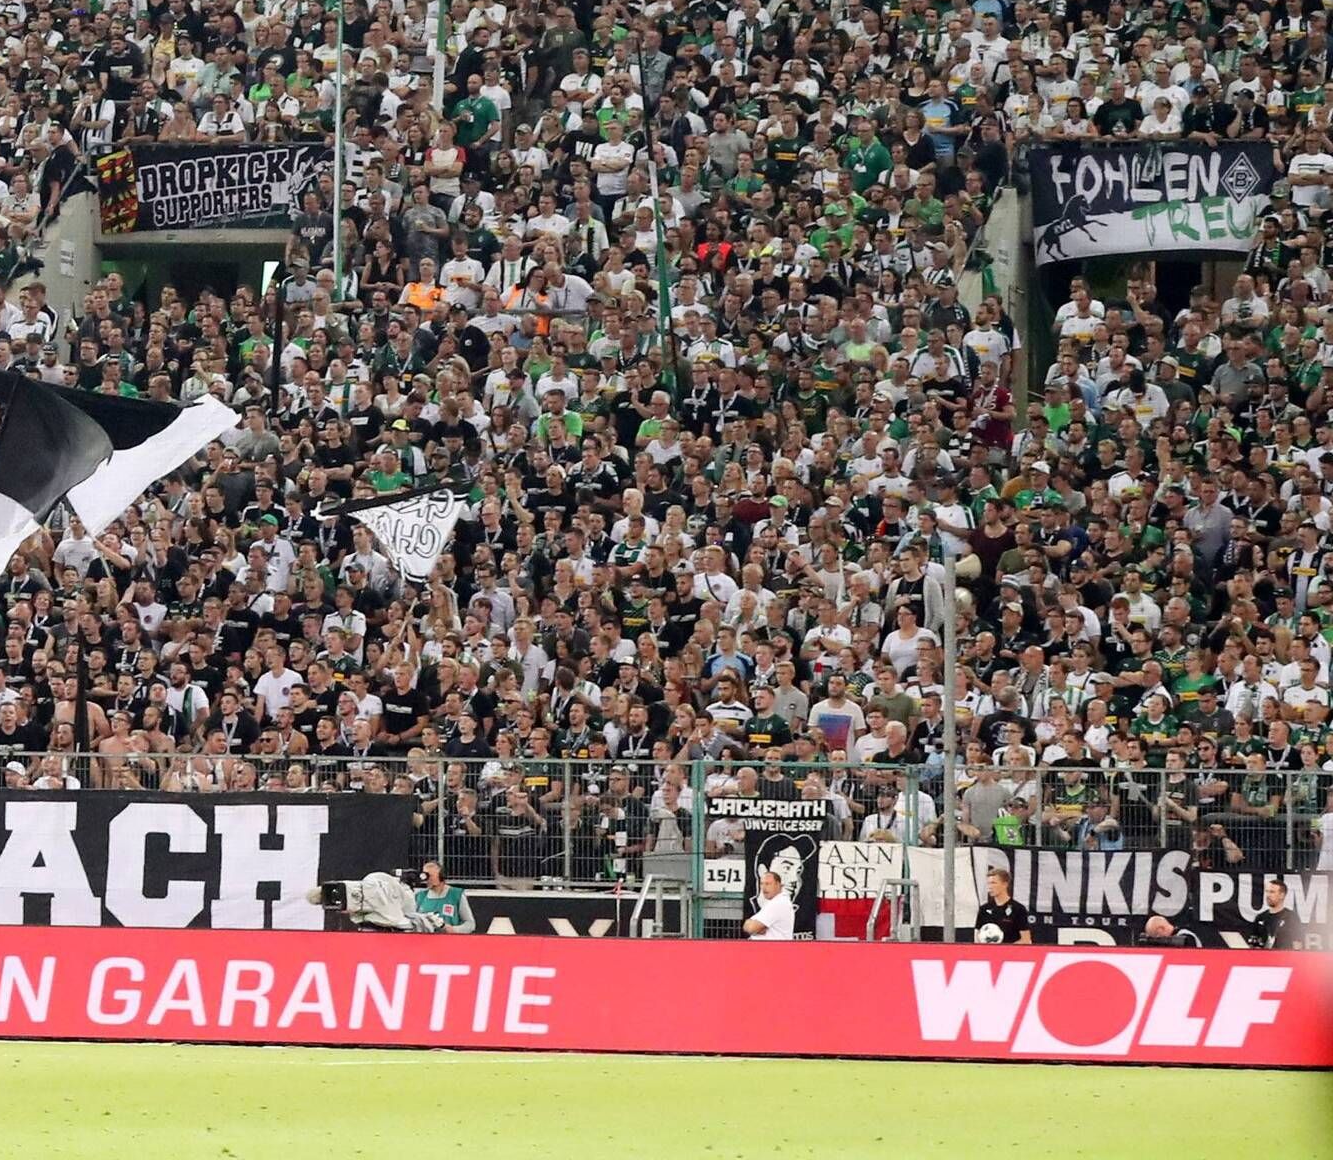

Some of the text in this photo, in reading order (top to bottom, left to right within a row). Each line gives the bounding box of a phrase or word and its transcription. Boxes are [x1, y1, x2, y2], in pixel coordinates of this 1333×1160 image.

[138, 148, 290, 203] DROPKICK
[1049, 151, 1222, 205] FOHLEN
[153, 182, 273, 227] SUPPORTERS
[1132, 195, 1259, 247] TREU
[709, 798, 826, 818] JACKERATH
[745, 819, 824, 832] UNVERGESSEN
[707, 869, 743, 884] 15/1
[830, 865, 876, 890] IST
[1071, 916, 1128, 927] TOUR
[86, 956, 556, 1034] GARANTIE
[910, 952, 1293, 1055] WOLF
